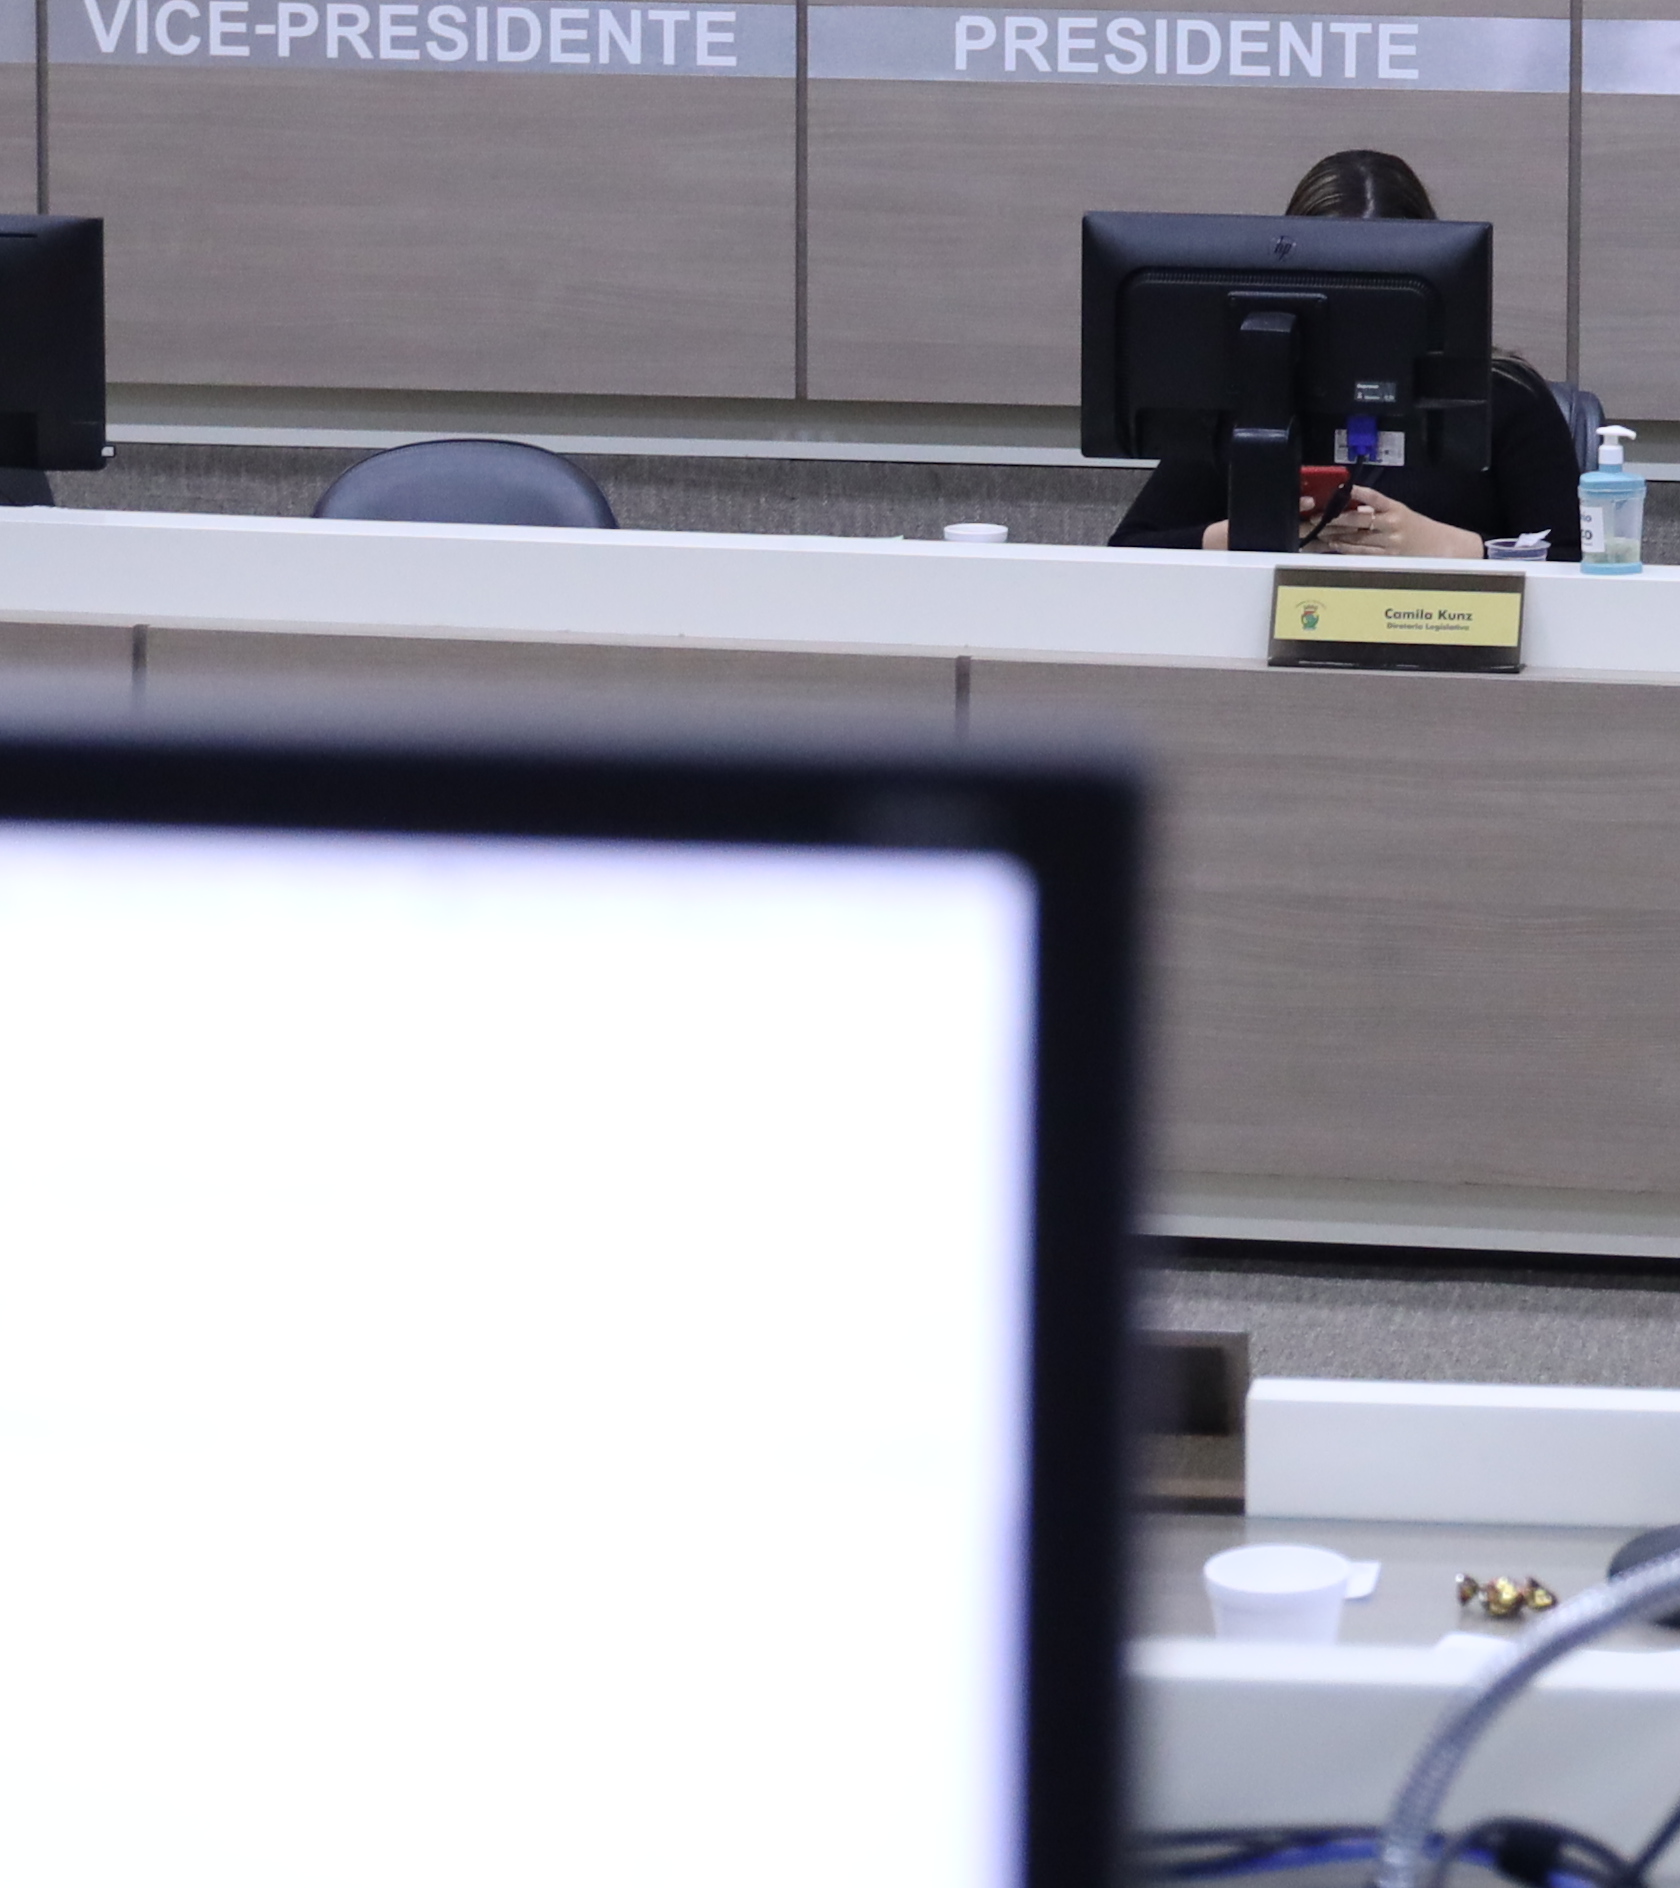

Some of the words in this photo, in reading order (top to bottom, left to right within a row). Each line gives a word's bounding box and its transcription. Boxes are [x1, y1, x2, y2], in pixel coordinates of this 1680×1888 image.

[952, 15, 1419, 80] PRESIDENTE
[1385, 608, 1432, 620] Camila
[1438, 610, 1472, 620] Kunz
